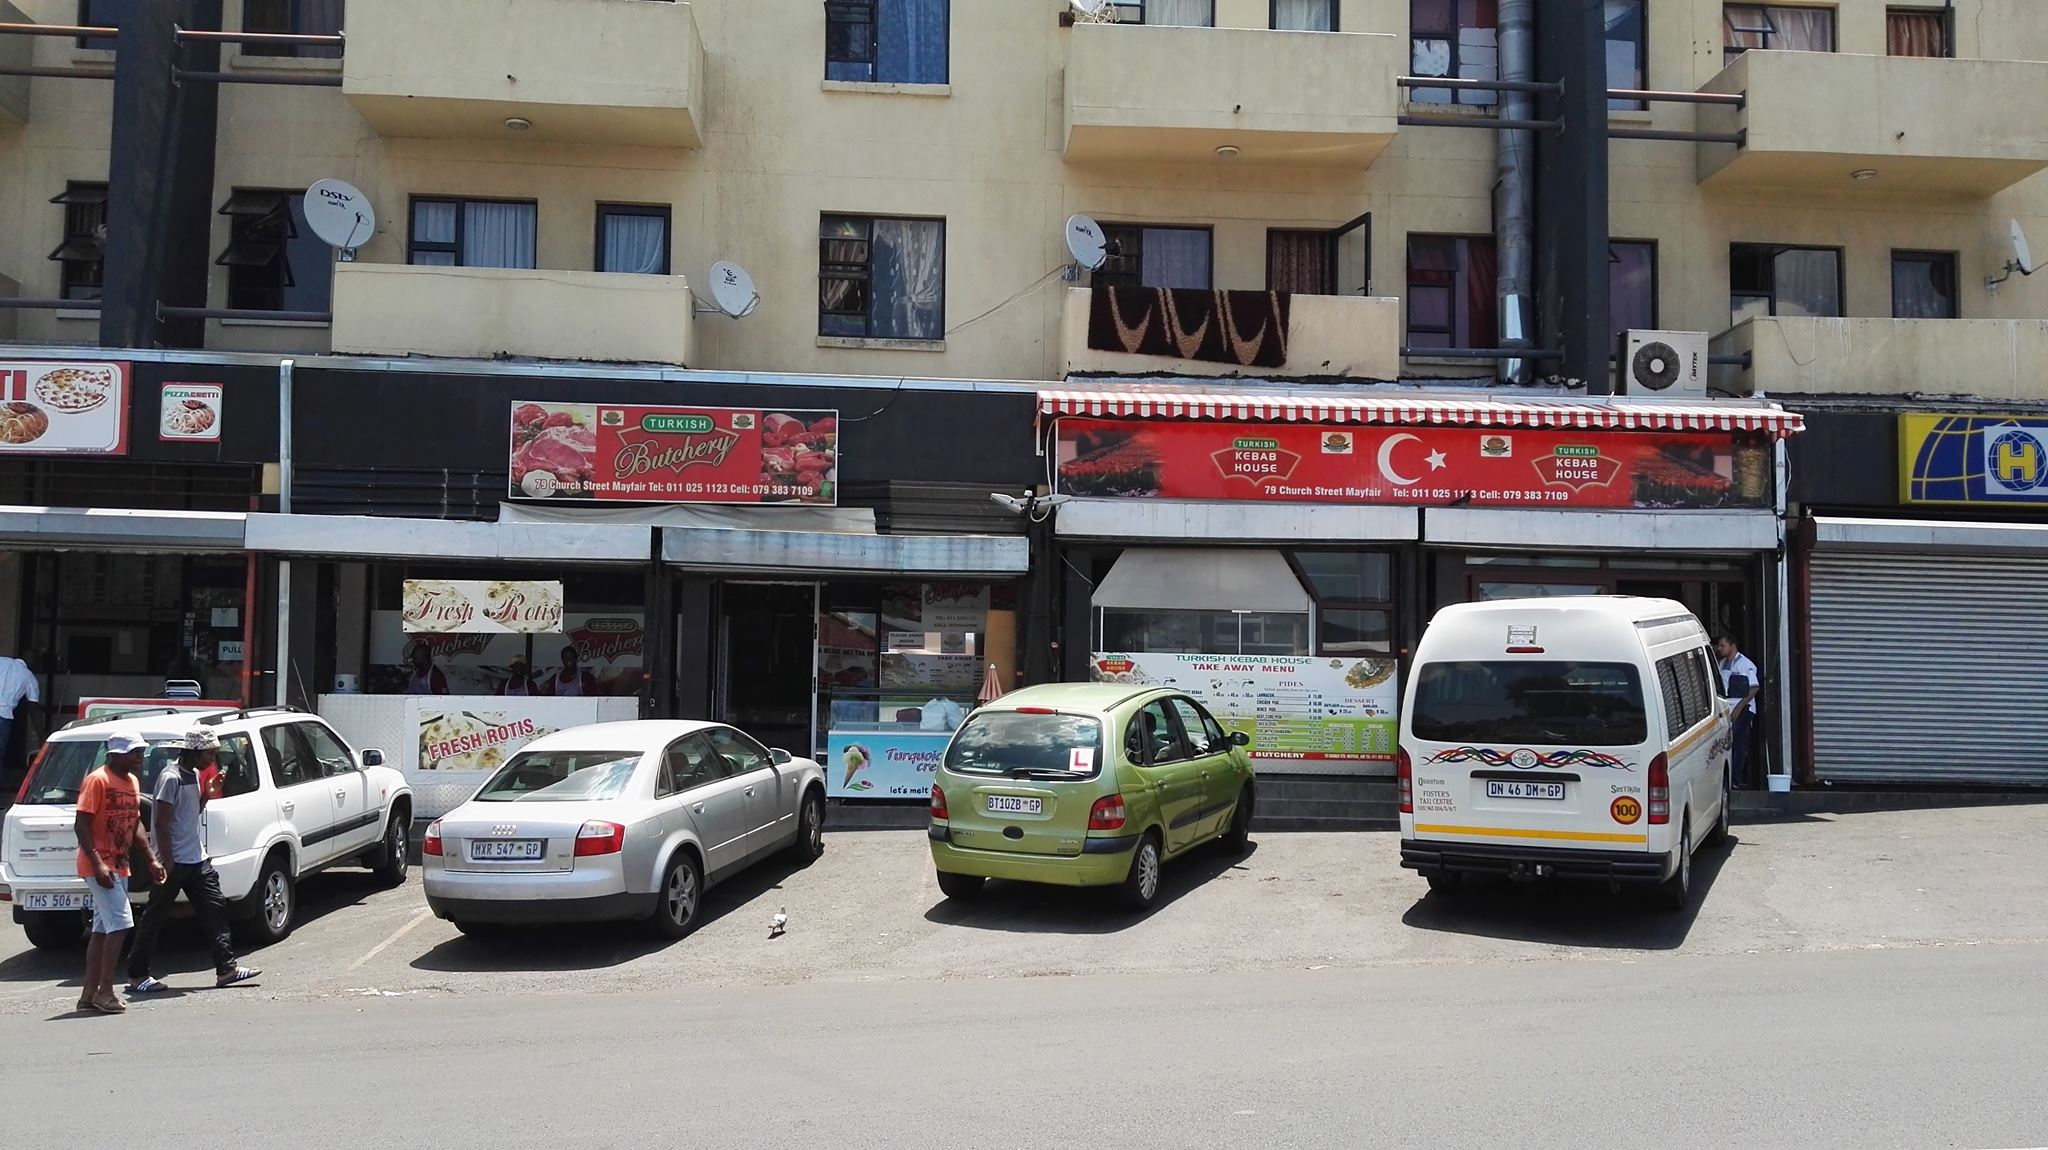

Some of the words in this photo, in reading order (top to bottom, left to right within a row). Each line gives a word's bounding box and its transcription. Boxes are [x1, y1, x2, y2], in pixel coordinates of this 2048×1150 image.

[650, 418, 707, 429] TURKISH
[1237, 441, 1275, 449] TURKISH
[1235, 451, 1277, 461] KEBAB
[1559, 447, 1596, 455] TURKISH
[614, 435, 732, 479] Butchery
[1998, 442, 2037, 481] H
[1234, 463, 1277, 473] HOUSE
[1556, 459, 1598, 468] KEBAB
[1555, 470, 1598, 479] HOUSE
[535, 480, 547, 489] 79
[550, 480, 580, 490] Church
[583, 480, 610, 491] Street
[612, 482, 646, 493] Mayfair
[649, 482, 664, 492] Tel:
[667, 483, 682, 492] 011
[686, 483, 703, 493] 025
[706, 484, 728, 494] 1123
[730, 484, 750, 494] Cell:
[752, 485, 769, 495] 079
[772, 485, 789, 495] 383
[791, 486, 813, 496] 7109
[1265, 485, 1276, 494] 79
[1279, 486, 1312, 496] Church
[1315, 486, 1343, 496] Street
[1346, 488, 1381, 498] Mayfair
[1393, 488, 1409, 498] Tel:
[1412, 489, 1429, 498] 011
[1432, 489, 1450, 498] 025
[1480, 489, 1500, 499] Cell:
[1503, 490, 1521, 499] 079
[1524, 491, 1542, 500] 383
[1545, 491, 1568, 501] 7109
[407, 592, 473, 621] Fresh
[489, 592, 558, 621] Rotis
[223, 646, 242, 654] PULL
[1229, 656, 1267, 664] KEBAB
[1192, 663, 1220, 671] TAKE
[1224, 664, 1255, 672] AWAY
[1262, 665, 1295, 673] MENU
[428, 732, 483, 761] FRESH
[486, 718, 535, 746] ROTIS
[1074, 751, 1088, 767] L
[889, 785, 908, 794] let's
[910, 786, 929, 794] melt
[1491, 783, 1503, 795] DN
[1508, 784, 1520, 795] 46
[1526, 785, 1539, 796] DM
[1548, 785, 1560, 797] GP
[1030, 801, 1040, 812] GP
[1615, 804, 1637, 816] 100
[475, 840, 492, 855] MXR
[497, 840, 514, 855] 547
[526, 840, 538, 855] GP
[29, 895, 47, 908] THS
[53, 895, 71, 907] 506
